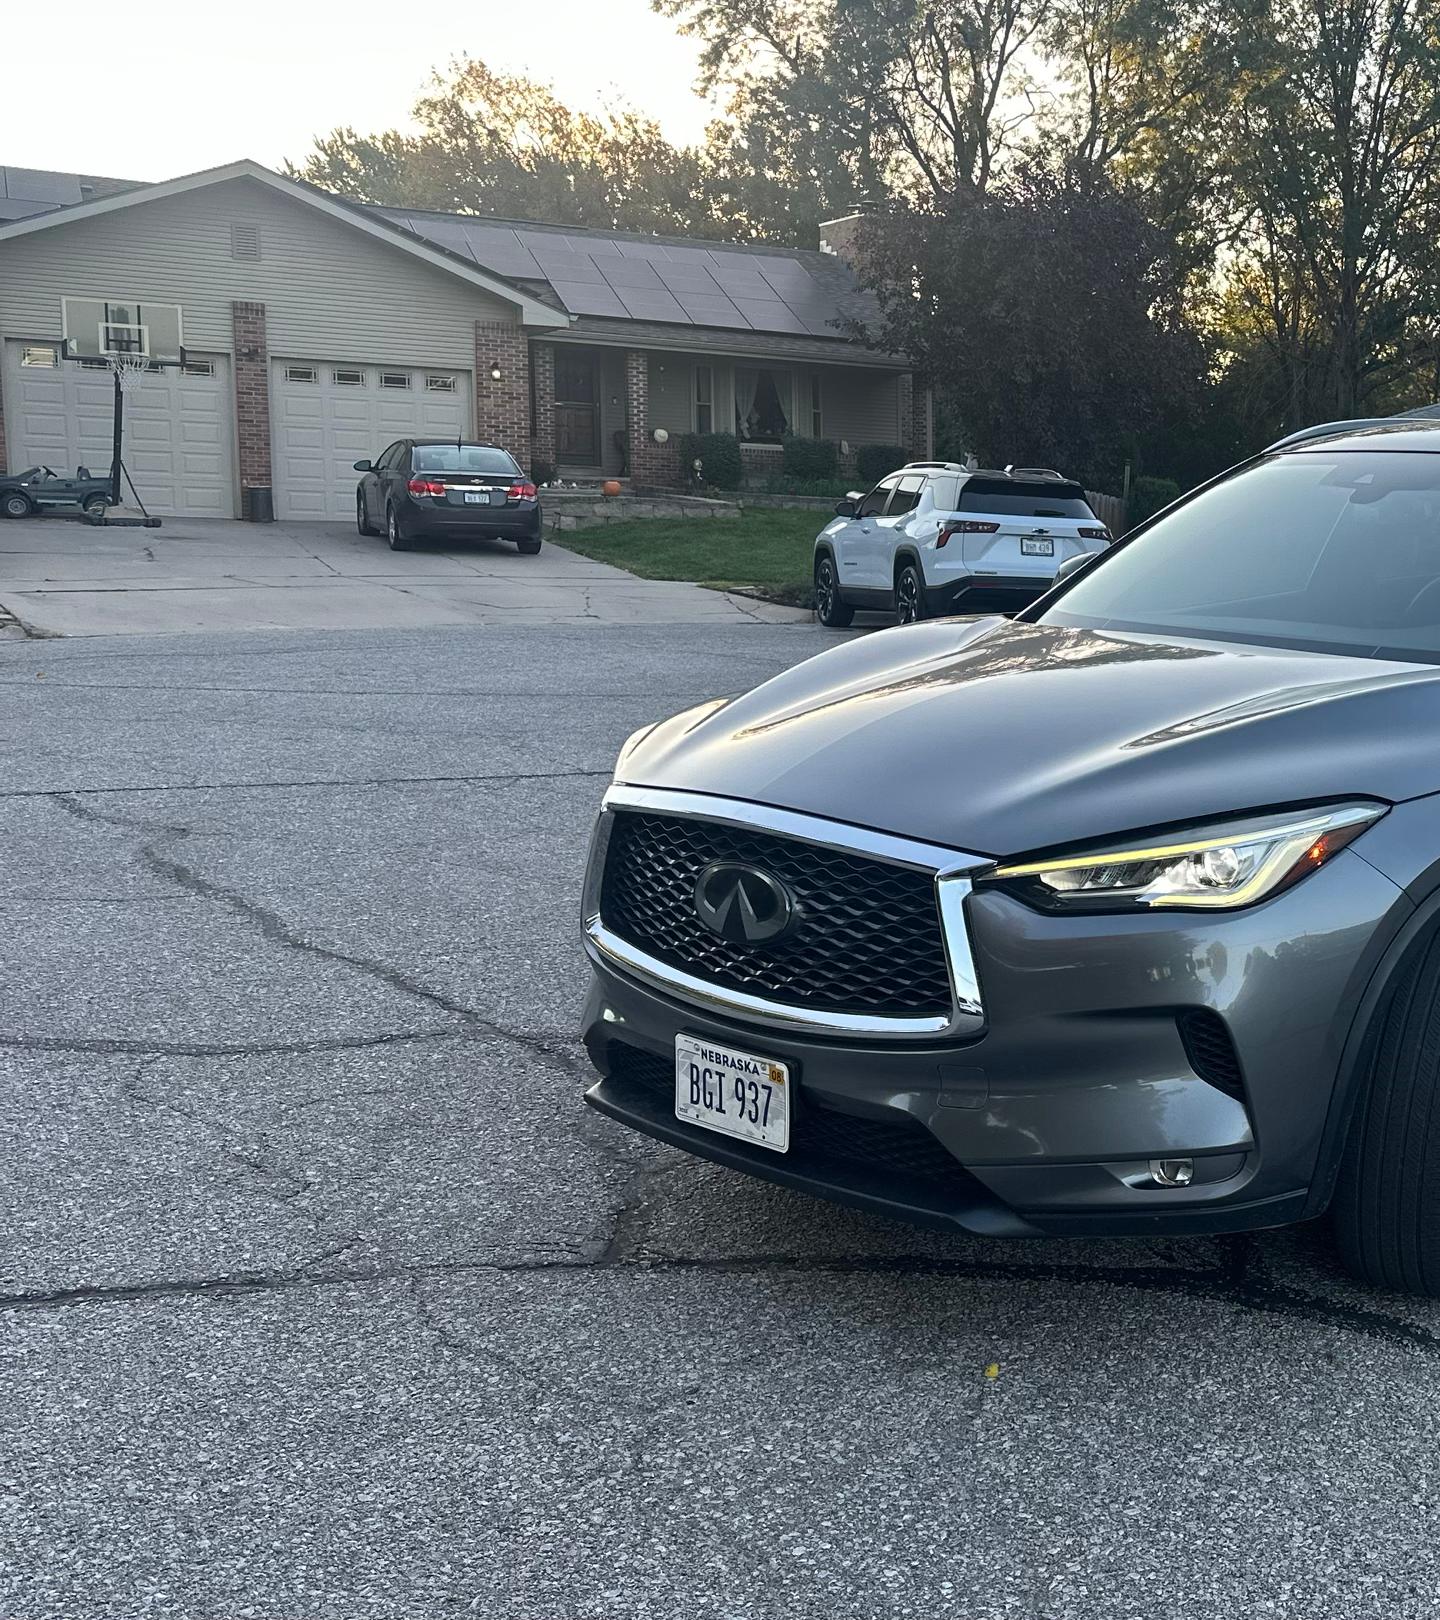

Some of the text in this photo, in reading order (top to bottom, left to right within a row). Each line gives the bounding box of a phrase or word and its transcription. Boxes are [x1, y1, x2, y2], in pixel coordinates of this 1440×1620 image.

[700, 1048, 760, 1076] NEBRASKA
[690, 1062, 773, 1127] BGI 937
